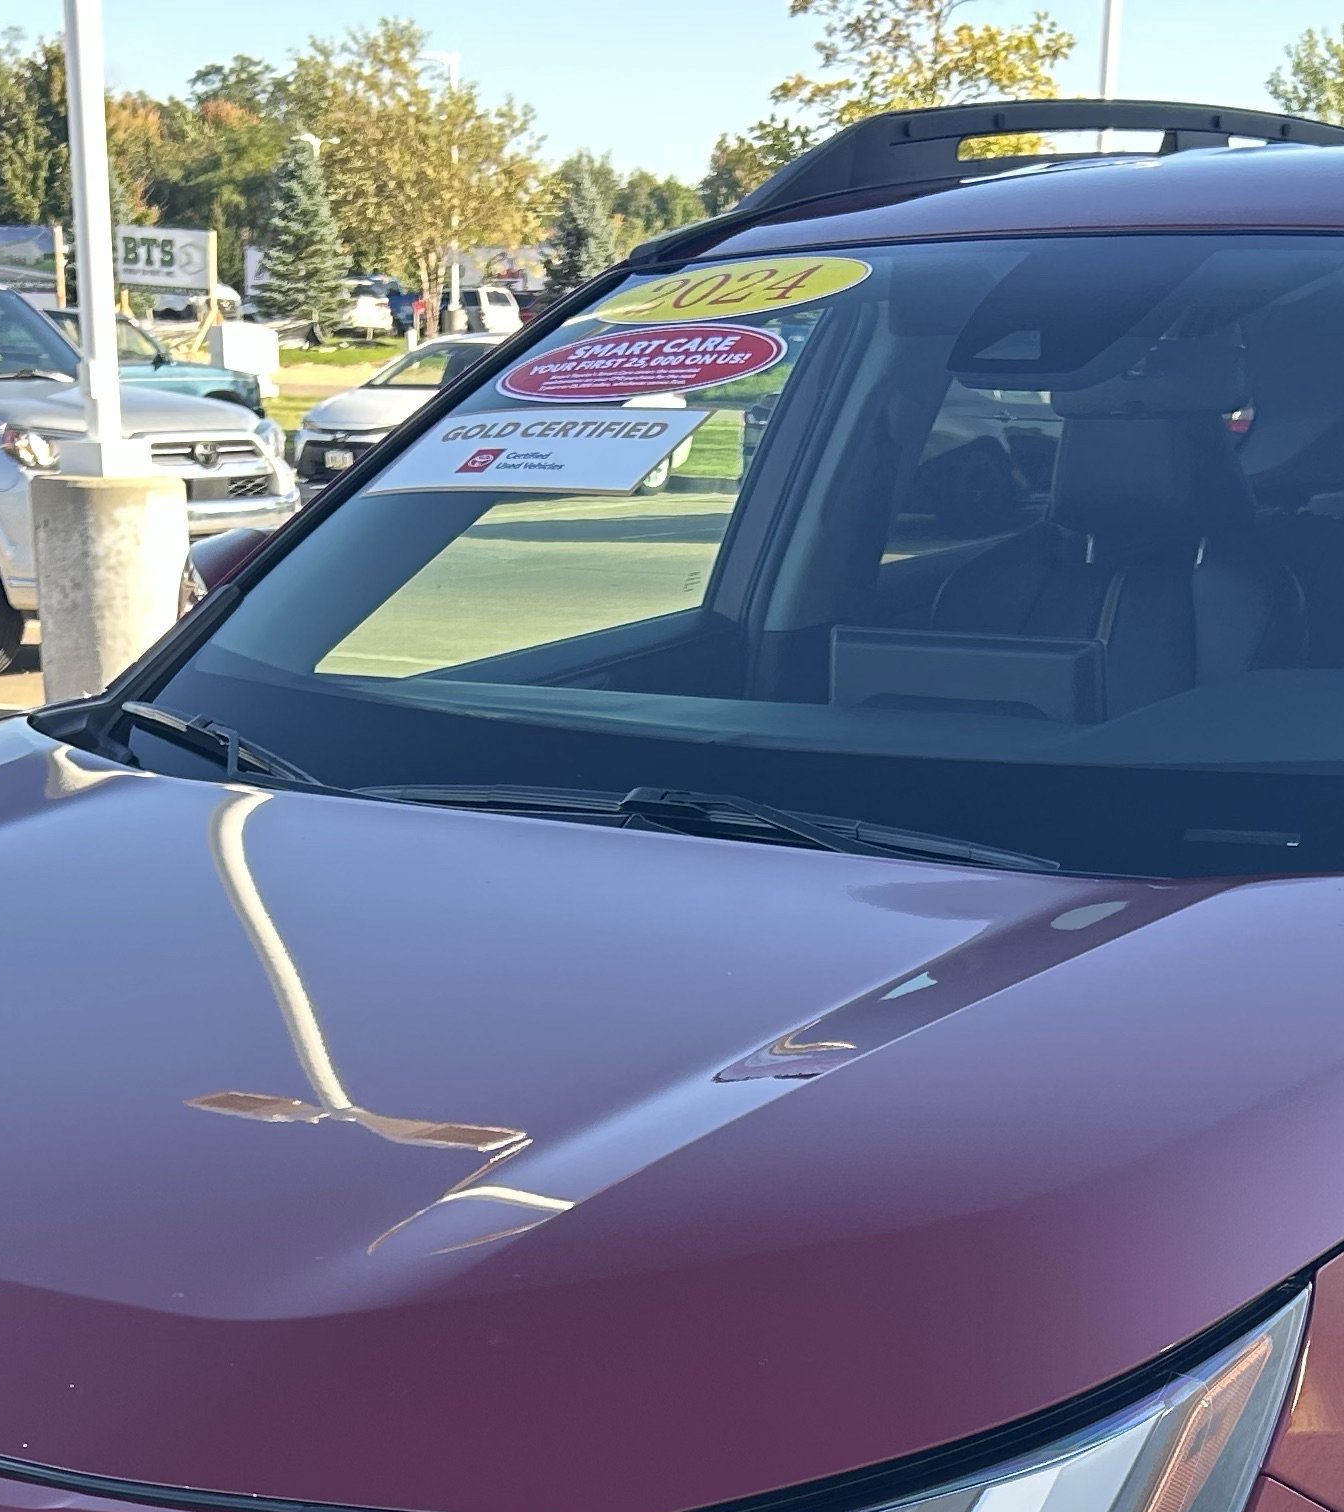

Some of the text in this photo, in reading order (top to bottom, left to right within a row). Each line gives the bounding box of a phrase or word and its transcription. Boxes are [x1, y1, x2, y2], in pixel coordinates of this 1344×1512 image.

[122, 237, 174, 267] BTS
[623, 264, 825, 316] 2024
[567, 336, 742, 360] SMART CARE
[529, 361, 577, 375] YOUR
[574, 358, 627, 371] FIRST
[684, 353, 718, 365] ON
[715, 352, 753, 364] US!
[441, 421, 669, 442] GOLD CERTIFIED
[506, 452, 552, 460] Certified
